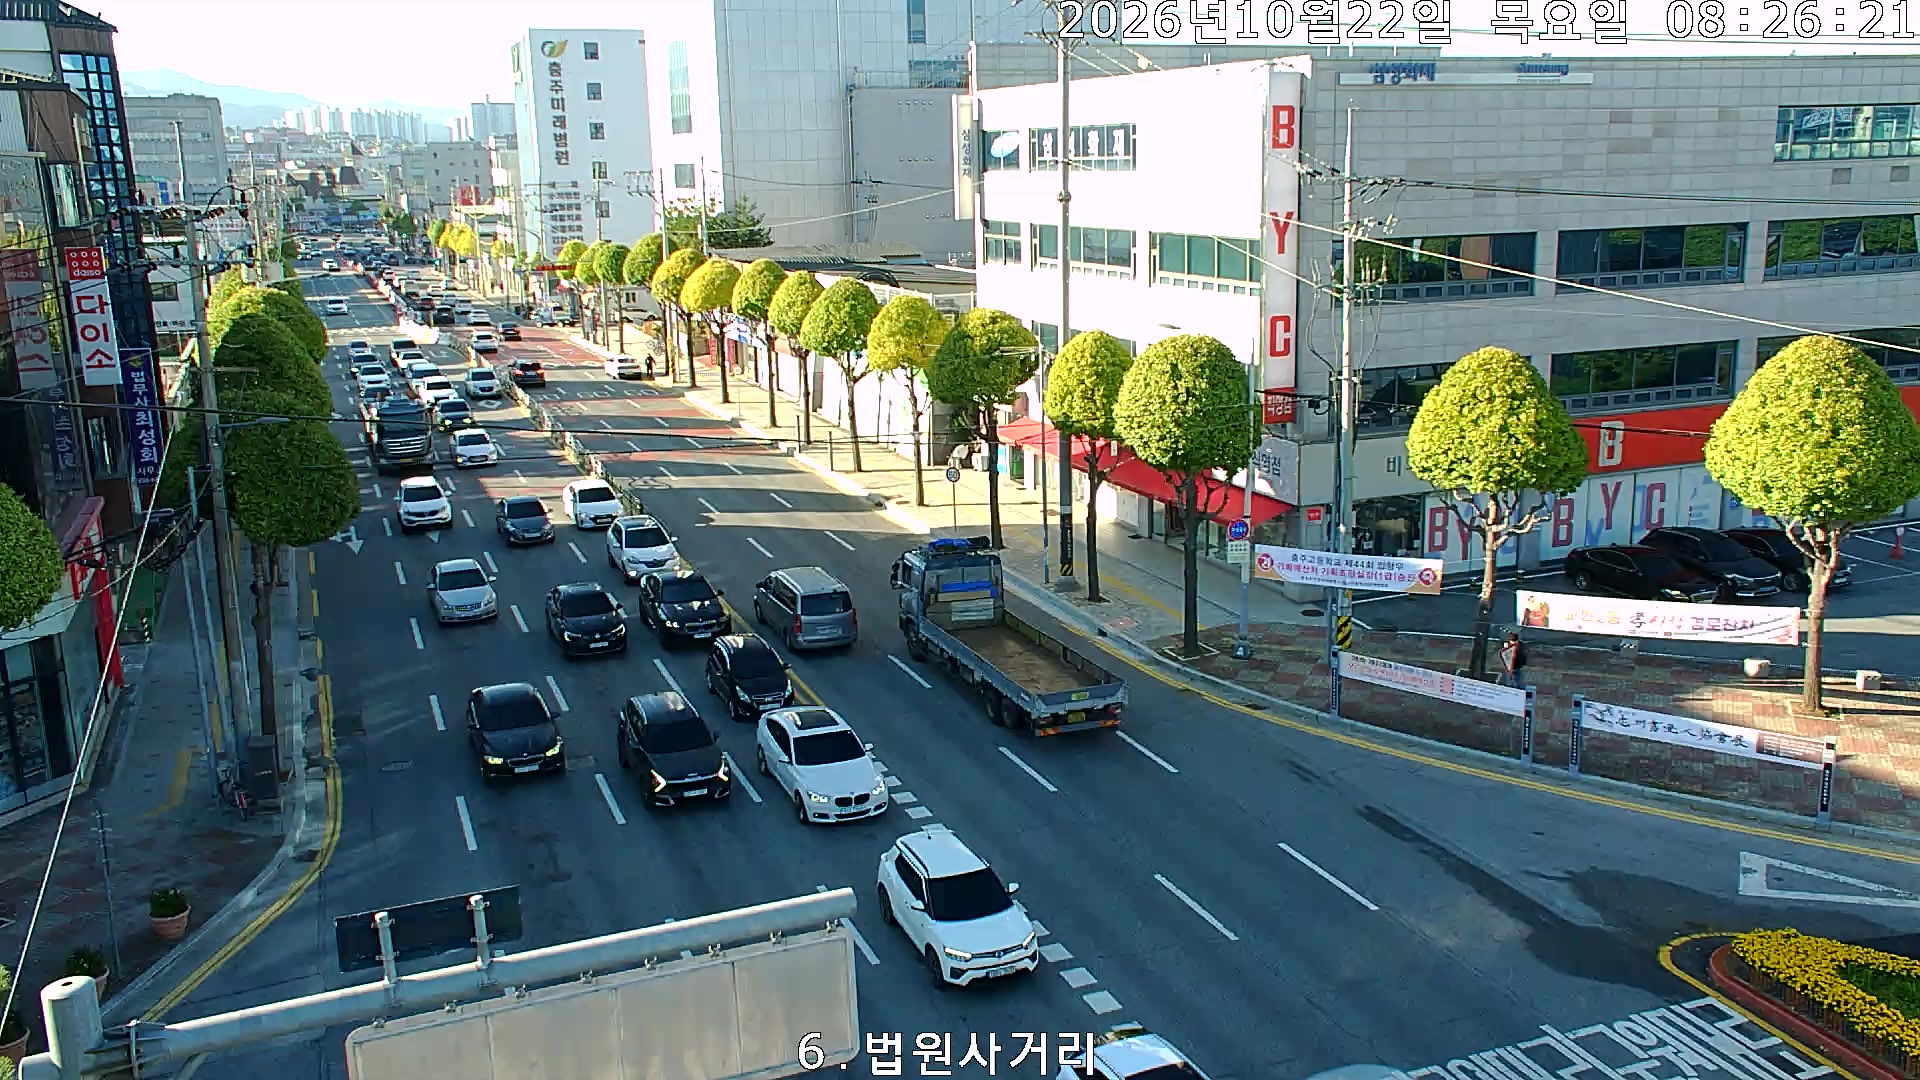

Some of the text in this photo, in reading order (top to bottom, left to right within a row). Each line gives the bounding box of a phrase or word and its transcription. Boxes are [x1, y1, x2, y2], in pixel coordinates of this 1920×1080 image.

[549, 61, 570, 165] 충주미래병원
[961, 129, 972, 178] 삼성화재
[1269, 104, 1294, 358] BYC
[73, 268, 101, 277] daiso
[75, 295, 117, 370] 다이소
[131, 371, 152, 406] 법무사
